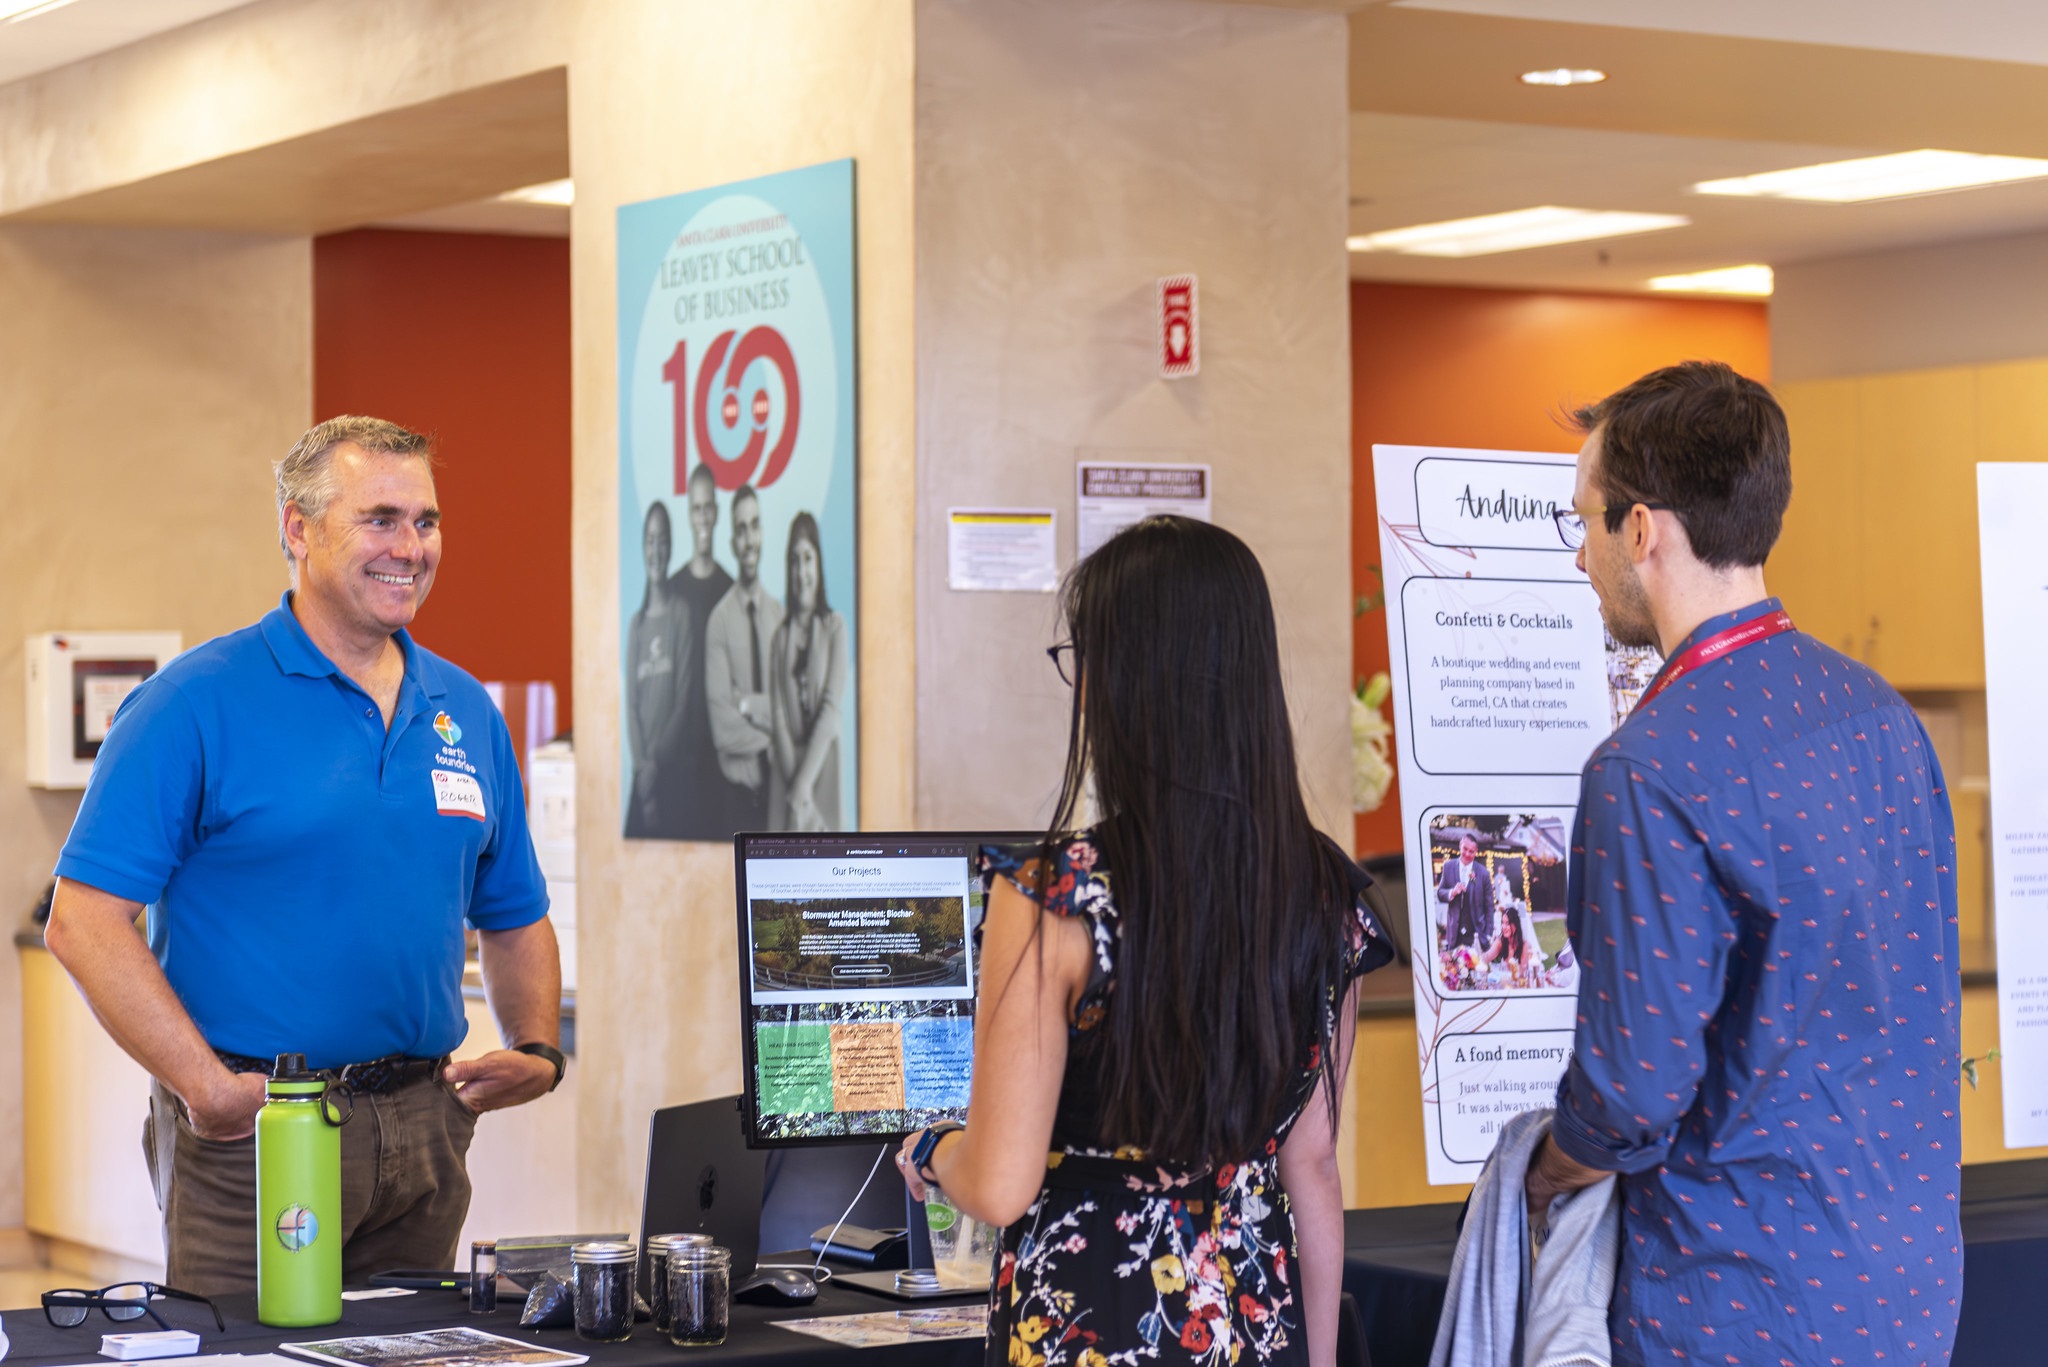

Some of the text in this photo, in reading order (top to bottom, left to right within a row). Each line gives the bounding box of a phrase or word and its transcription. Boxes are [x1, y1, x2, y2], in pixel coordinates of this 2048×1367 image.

[660, 235, 805, 290] LEAVEY SCHOOL
[674, 278, 791, 325] OF BUSINESS
[662, 325, 801, 496] 100
[1456, 484, 1557, 523] Andrina
[1435, 611, 1573, 629] Confetti & Cocktails
[1431, 656, 1581, 672] A boutique wedding and event
[1440, 676, 1575, 692] planning company based in
[1451, 696, 1568, 710] Carmel, CA that creates
[1430, 715, 1590, 731] handcrafted luxury experiences.
[442, 746, 466, 760] earth
[435, 753, 476, 774] foundries
[832, 866, 882, 877] Our Projects
[802, 909, 914, 920] Stormwater Management: Biochar-
[828, 918, 890, 927] Amended Bioswale
[1455, 1048, 1466, 1062] A
[1470, 1045, 1502, 1062] fond
[1506, 1047, 1564, 1062] memory
[1460, 1082, 1480, 1096] Just
[1484, 1080, 1526, 1094] walking
[1457, 1103, 1466, 1114] It
[1470, 1104, 1490, 1113] was
[1494, 1100, 1530, 1112] always
[1480, 1121, 1494, 1134] all
